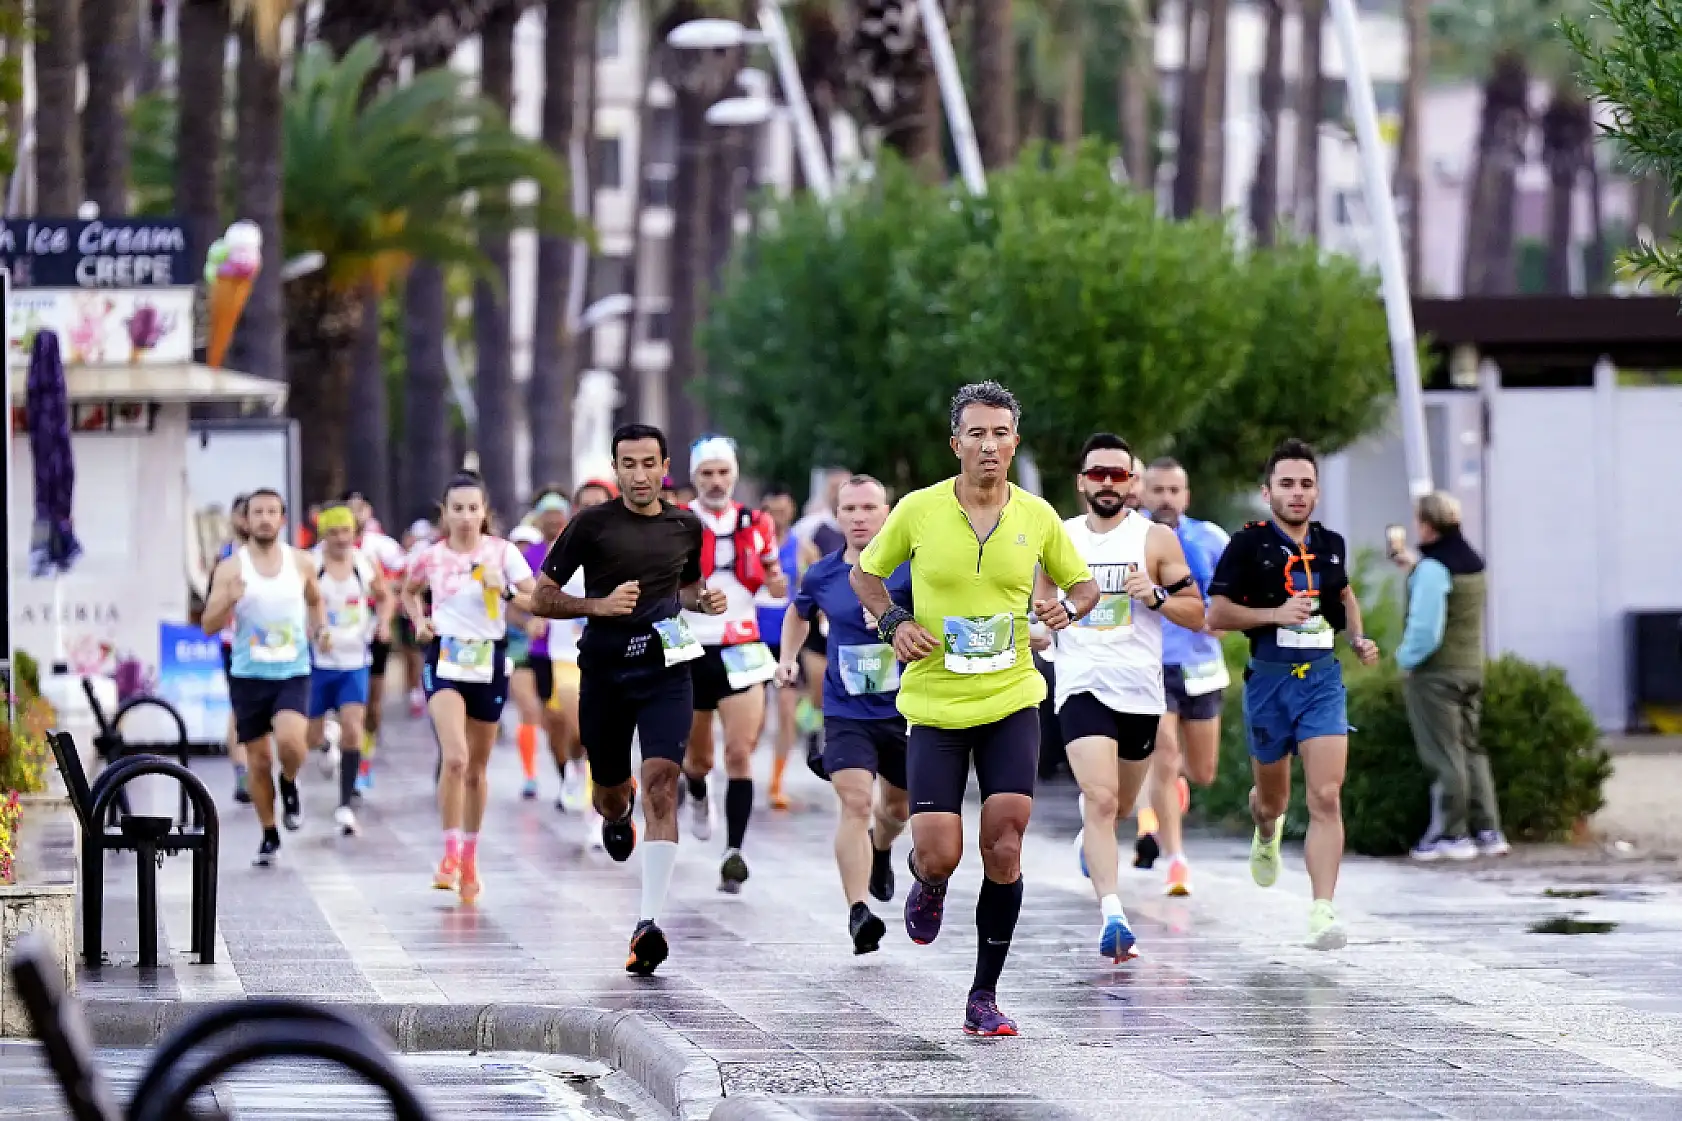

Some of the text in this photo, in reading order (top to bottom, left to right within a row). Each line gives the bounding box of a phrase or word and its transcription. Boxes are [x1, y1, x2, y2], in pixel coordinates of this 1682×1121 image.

[26, 221, 69, 255] Ice
[78, 221, 184, 254] Cream
[76, 254, 173, 287] CREPE
[969, 631, 995, 646] 353
